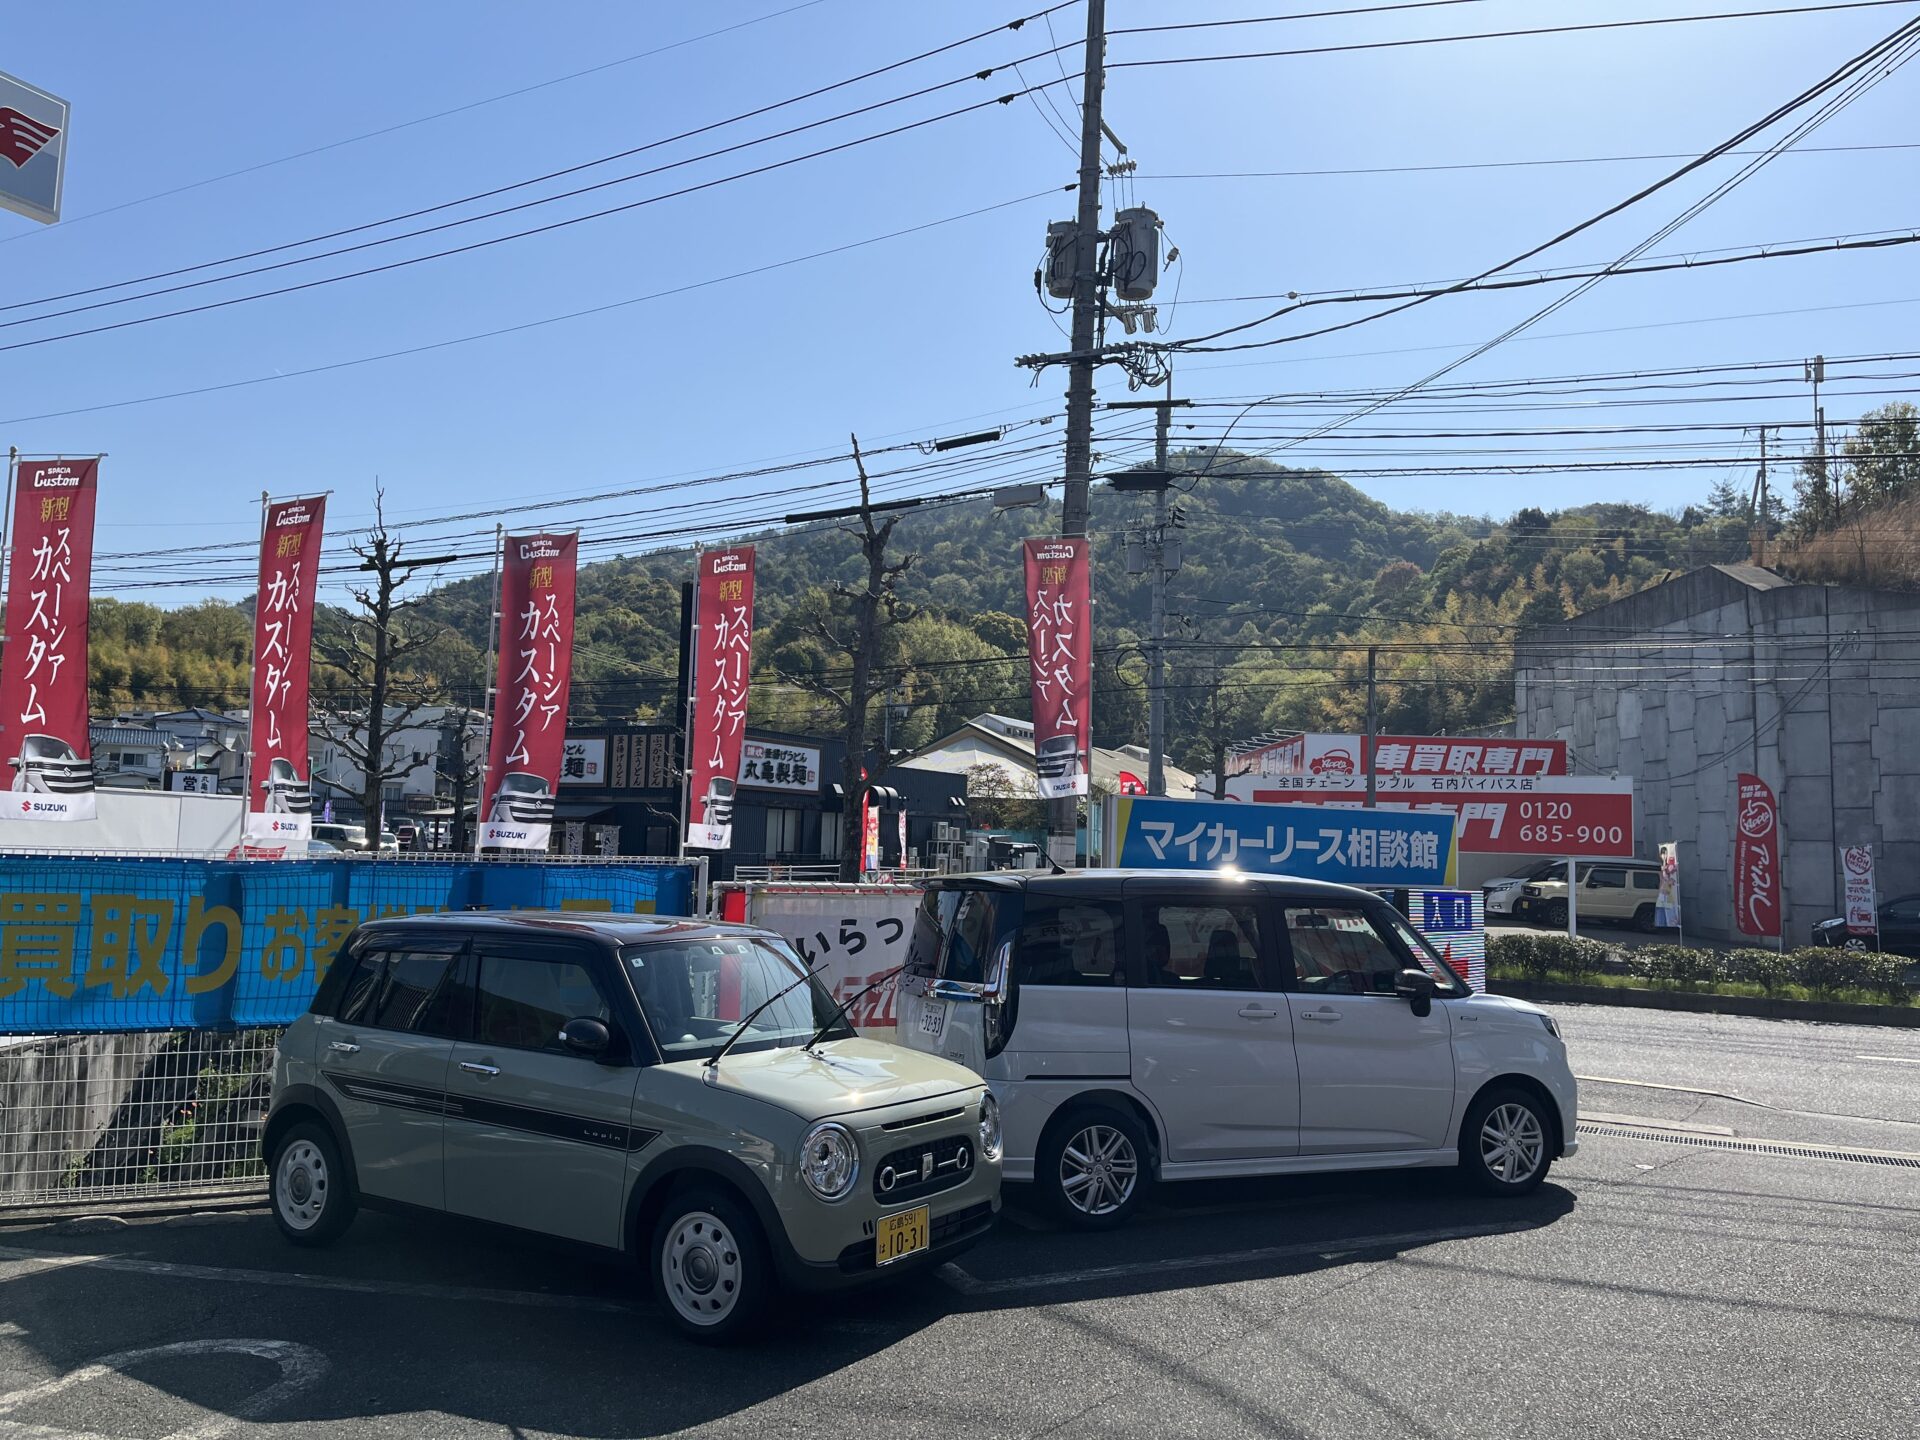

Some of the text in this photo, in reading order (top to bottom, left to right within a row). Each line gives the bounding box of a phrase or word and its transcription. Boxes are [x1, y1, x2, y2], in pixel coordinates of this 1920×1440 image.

[33, 469, 80, 488] Custom
[47, 466, 71, 475] SPACIA
[40, 496, 70, 523] 新型
[276, 509, 311, 527] Custom
[288, 504, 306, 513] SPACIA
[276, 533, 303, 559] 新型
[519, 543, 560, 560] Custom
[531, 539, 552, 548] SPACIA
[713, 559, 747, 575] Custom
[721, 555, 739, 563] SPACIA
[528, 567, 553, 590] 新型
[719, 579, 743, 602] 新型
[48, 527, 72, 686] スペーシア
[20, 535, 52, 727] カスタム
[280, 560, 301, 712] スペーシア
[261, 571, 287, 749] カスタム
[540, 593, 563, 733] スペーシア
[727, 605, 750, 738] スペーシア
[504, 600, 540, 766] カスタム
[708, 613, 730, 769] カスタム
[1374, 743, 1554, 775] 車買取専門
[183, 776, 197, 791] 営
[743, 760, 808, 785] 丸亀製麺
[1279, 776, 1355, 790] 全国チェーン
[1431, 776, 1534, 791] 石内バイパス店
[33, 802, 67, 813] SUZUKI
[1519, 801, 1573, 820] 0120
[495, 830, 528, 840] SUZUKI
[1140, 821, 1439, 871] マイカーリース相談館
[1519, 825, 1623, 845] 685-900
[1432, 896, 1466, 927] 入口
[583, 1129, 622, 1141] Lapin
[904, 1212, 918, 1226] 591
[889, 1224, 925, 1257] 10-31
